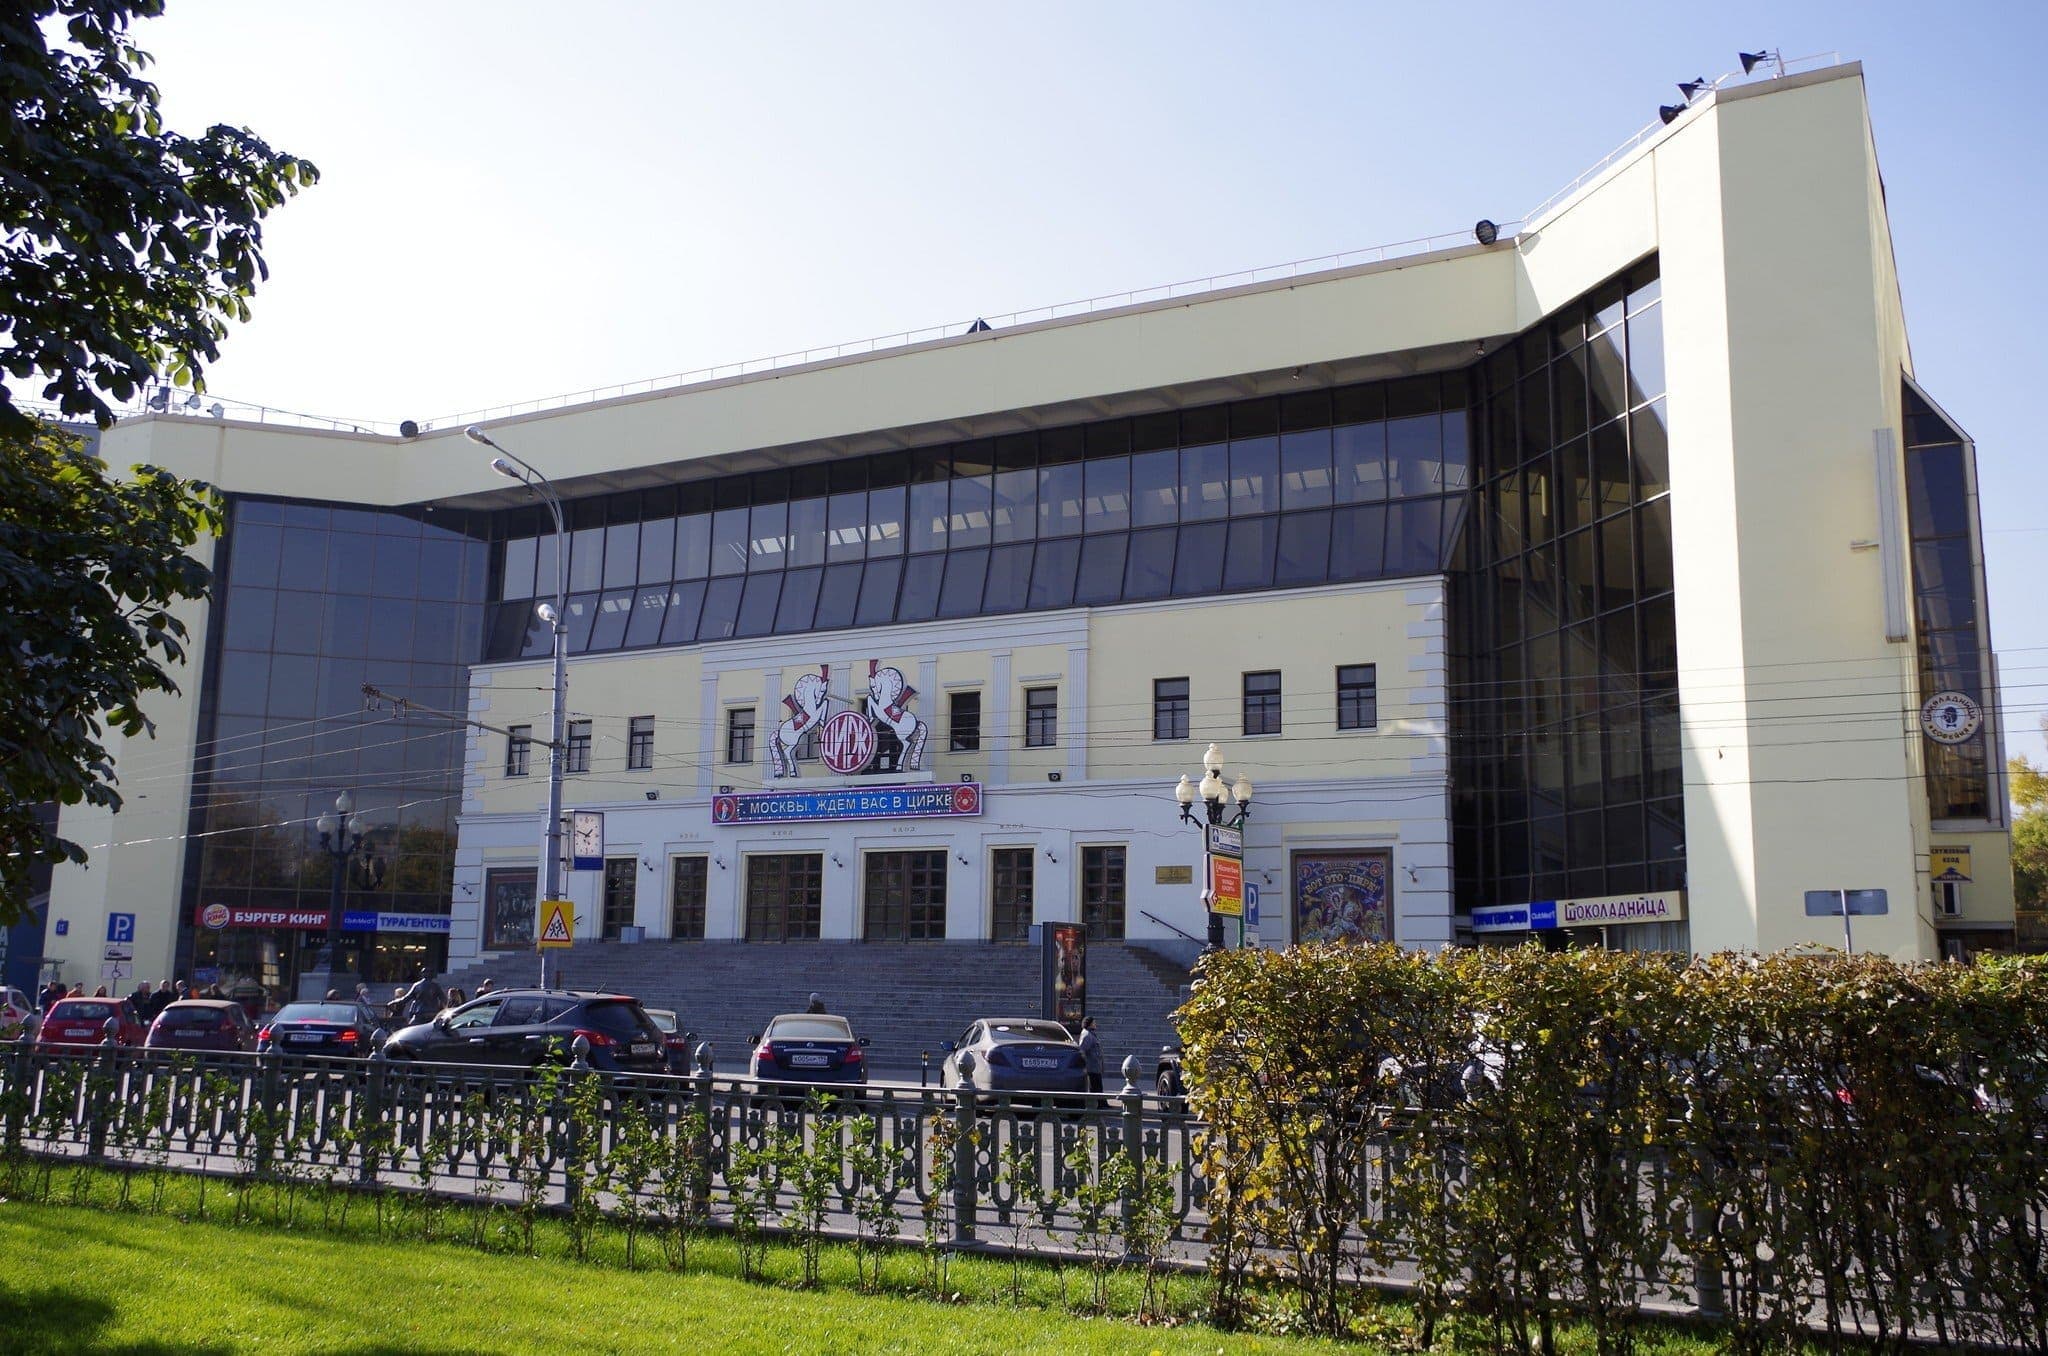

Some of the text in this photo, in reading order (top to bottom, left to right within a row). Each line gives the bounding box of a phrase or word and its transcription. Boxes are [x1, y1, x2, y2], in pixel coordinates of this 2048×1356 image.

[825, 715, 870, 769] ЦИРК
[750, 800, 811, 814] МОСКВЫ.
[816, 798, 856, 813] ЖДЕМ
[861, 796, 888, 810] ВАС
[892, 796, 901, 808] В
[907, 794, 952, 810] ЦИРКЕ
[1305, 878, 1323, 894] ВОТ
[1324, 873, 1344, 884] ЭТО
[234, 912, 326, 925] БУРГЕР КИНГ
[1564, 898, 1667, 922] ШОКОЛАДНИЦА
